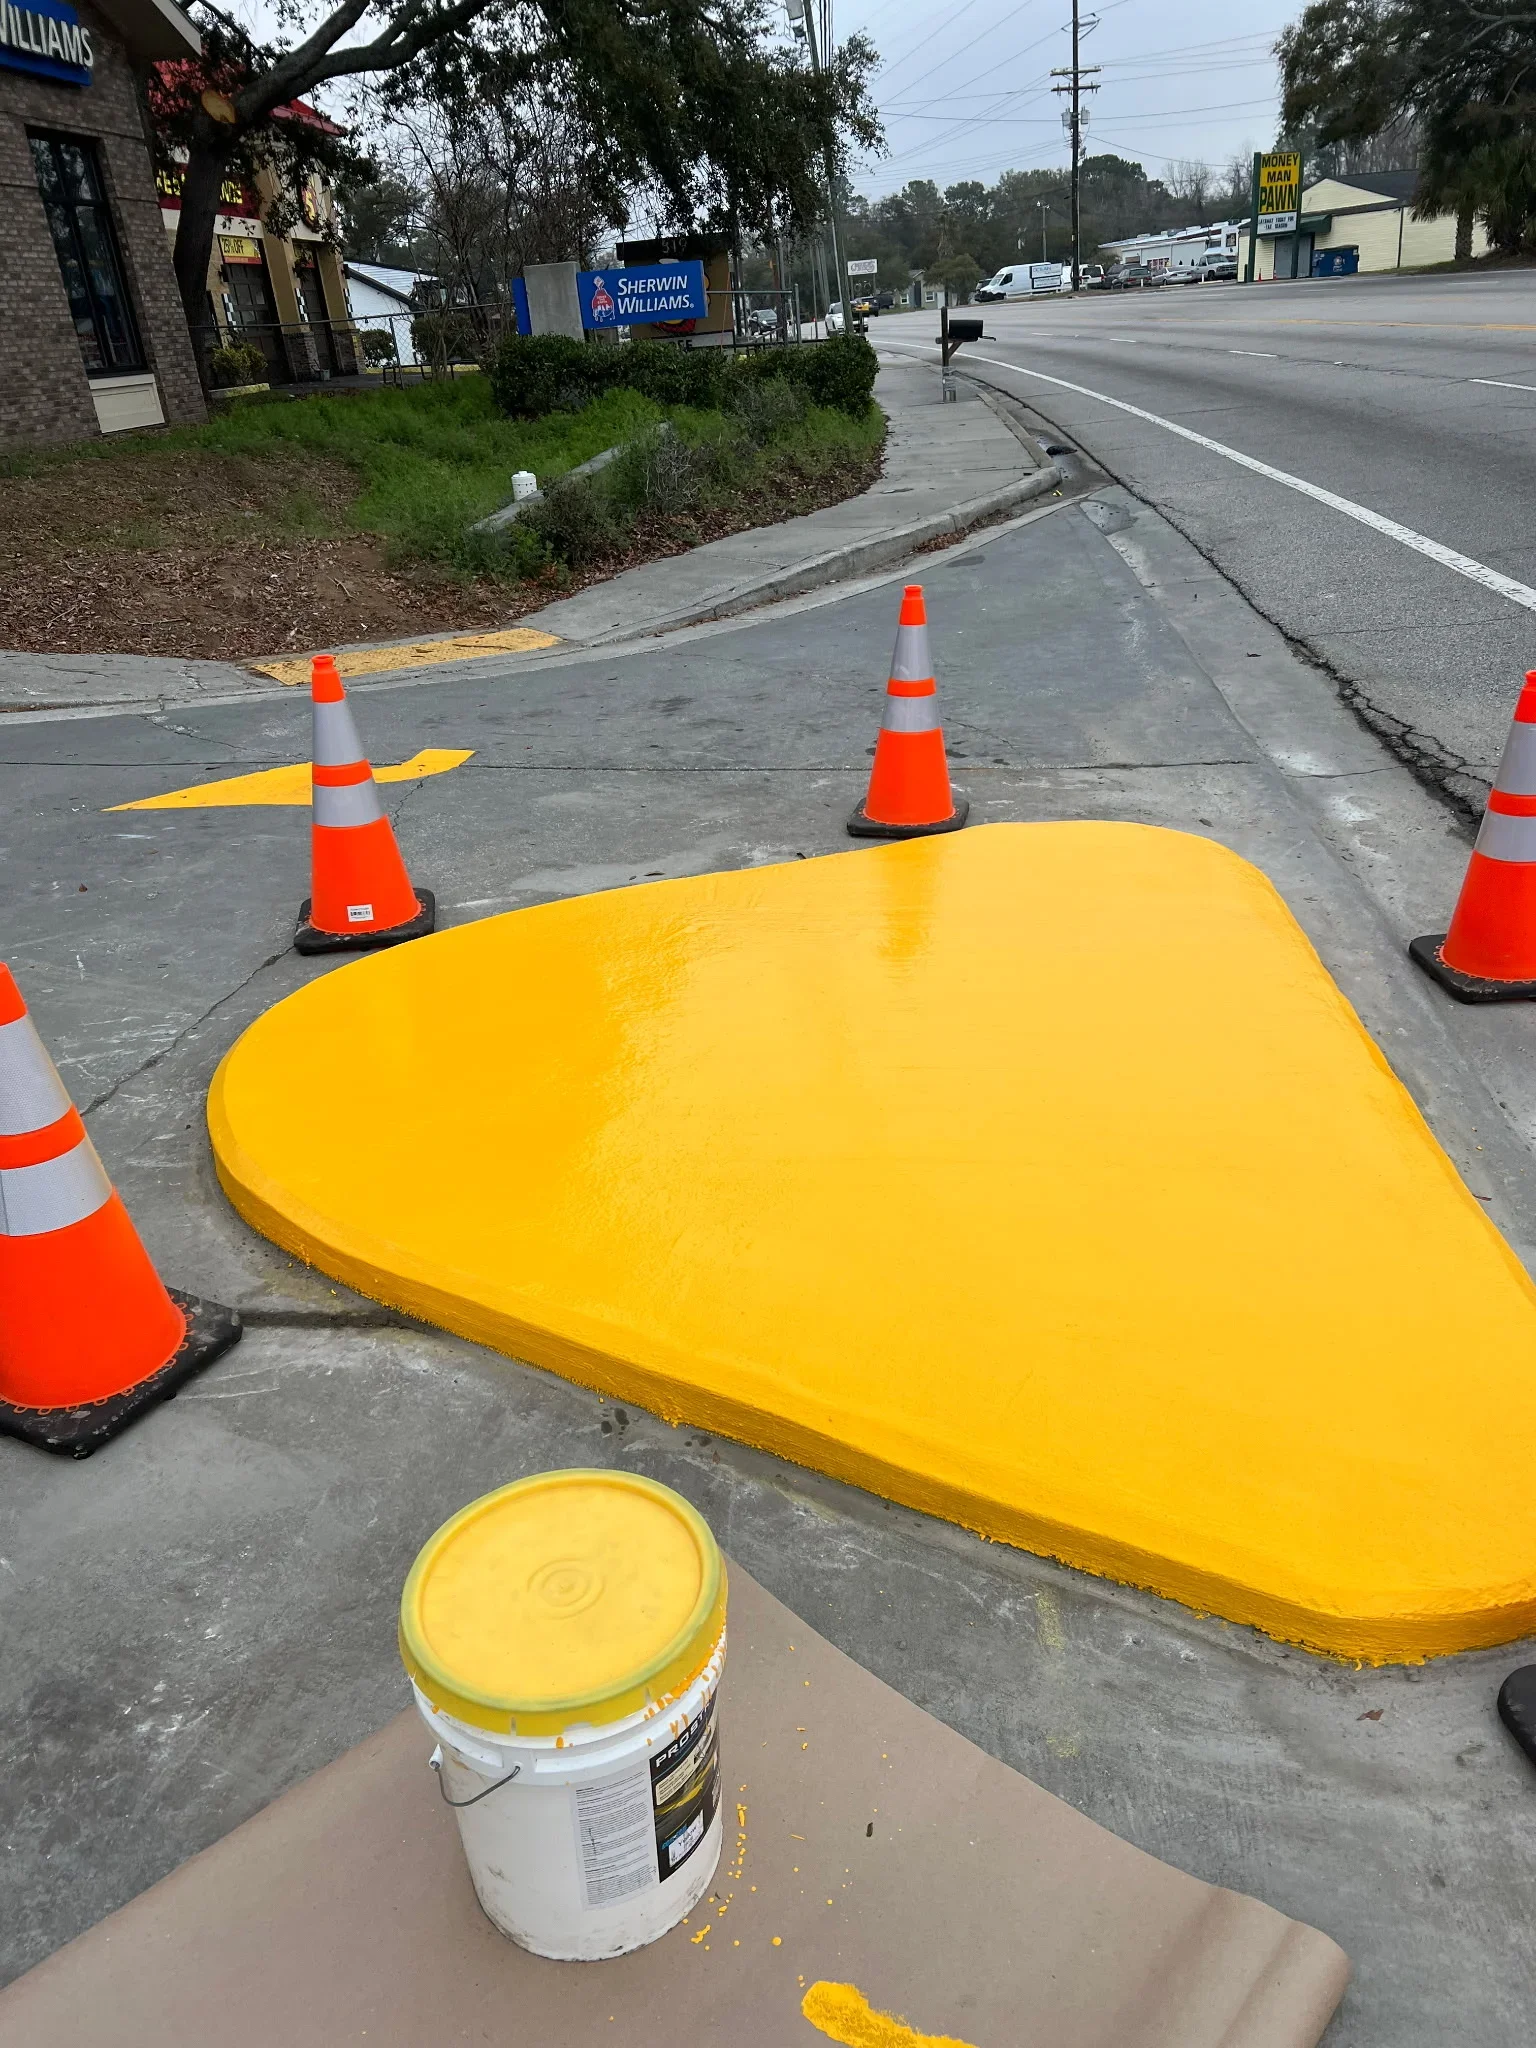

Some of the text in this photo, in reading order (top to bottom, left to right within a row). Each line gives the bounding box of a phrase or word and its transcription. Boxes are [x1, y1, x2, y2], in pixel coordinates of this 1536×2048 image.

[1261, 153, 1299, 168] MONEY
[1267, 170, 1291, 183] MAN
[1260, 184, 1297, 212] PAWN
[617, 275, 688, 296] SHERWIN
[617, 295, 690, 315] WILLIAMS
